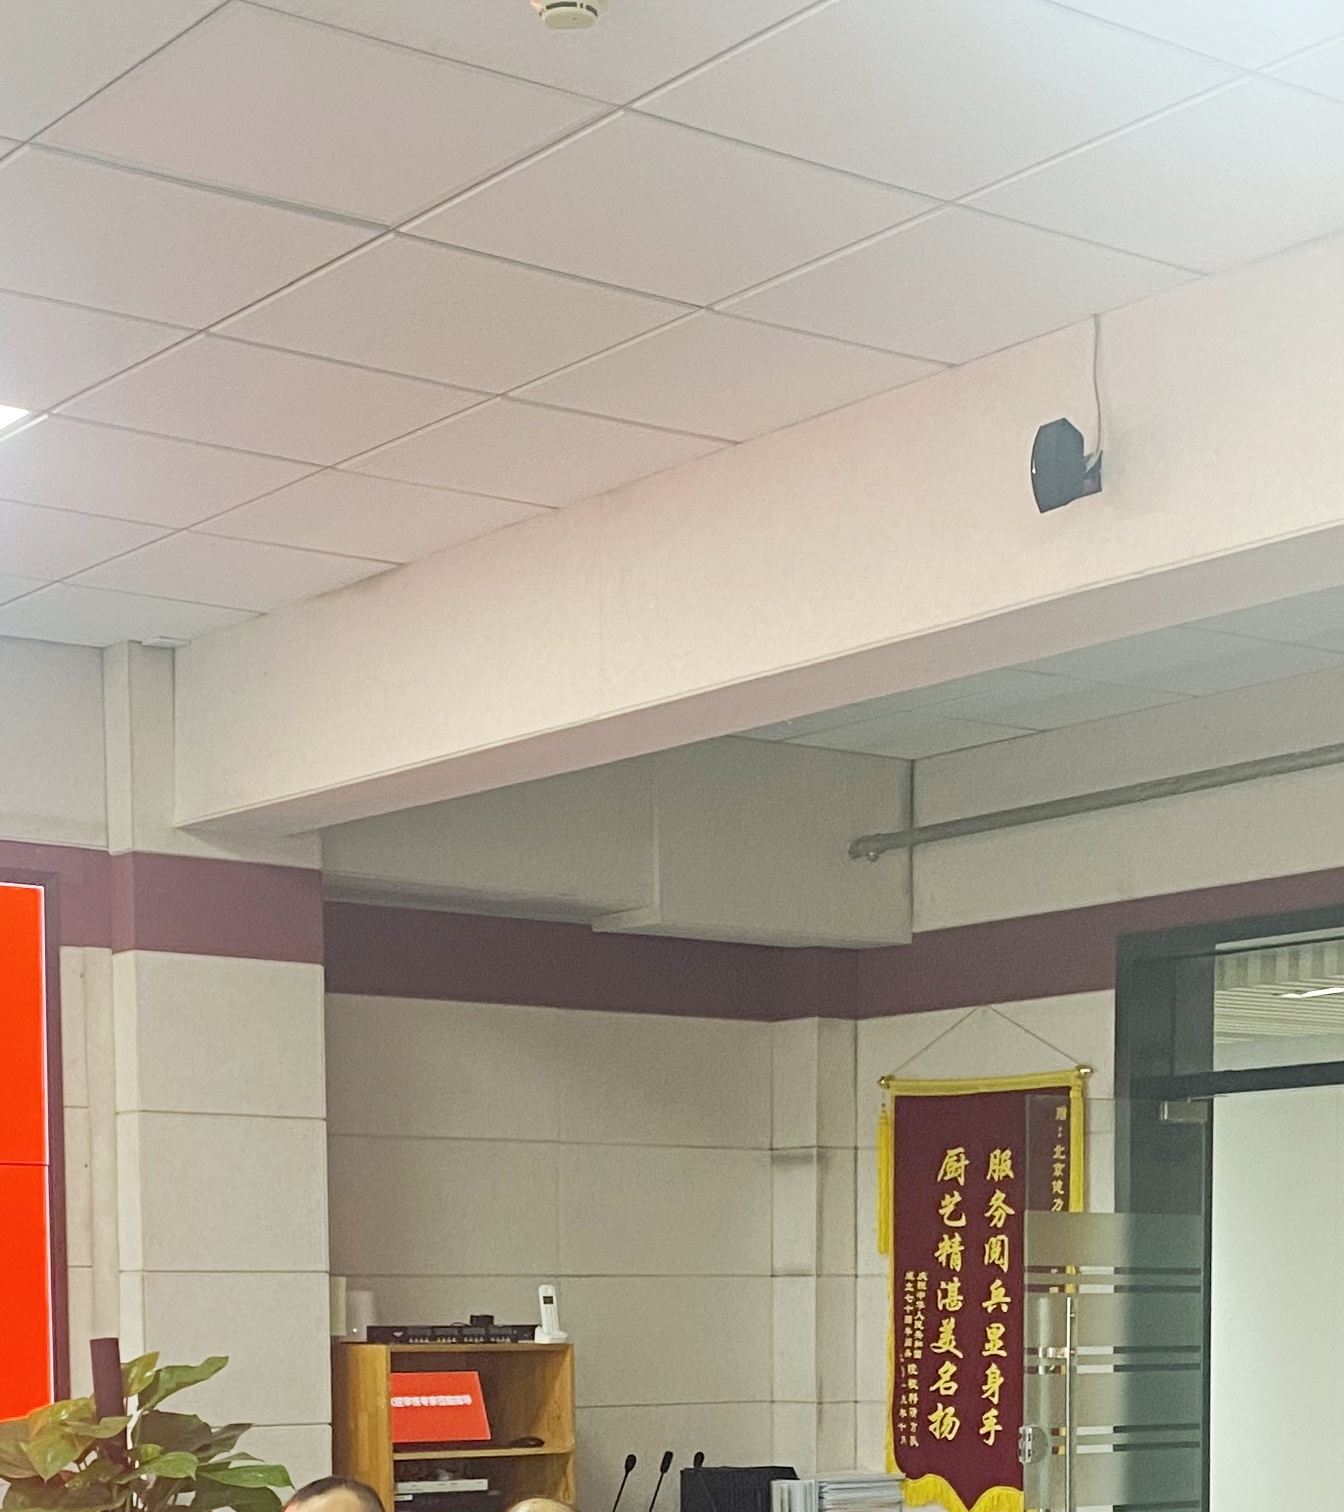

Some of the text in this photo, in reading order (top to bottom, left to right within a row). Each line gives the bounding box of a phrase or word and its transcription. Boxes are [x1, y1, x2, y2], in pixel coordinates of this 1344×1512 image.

[927, 1147, 970, 1441] 厨艺精湛美名扬
